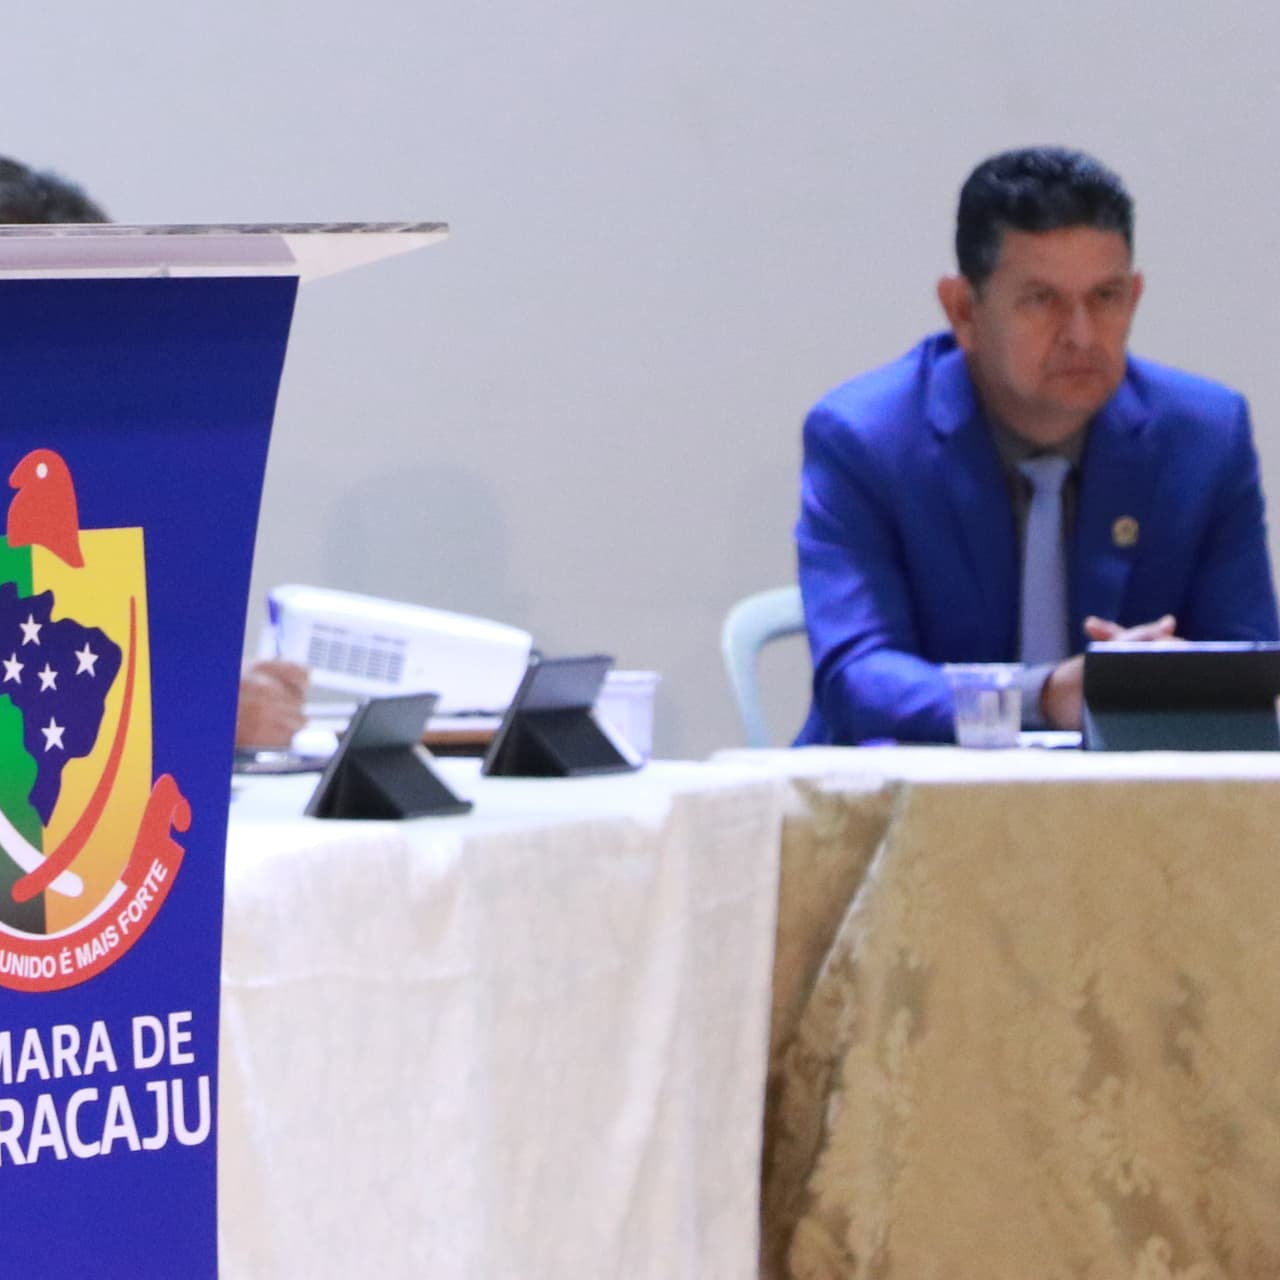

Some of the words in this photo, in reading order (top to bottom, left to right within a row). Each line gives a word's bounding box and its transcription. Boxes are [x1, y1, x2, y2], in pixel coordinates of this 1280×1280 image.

[59, 946, 74, 975] É
[75, 924, 120, 969] MAIS
[118, 858, 168, 935] FORTE
[132, 1011, 196, 1069] DE
